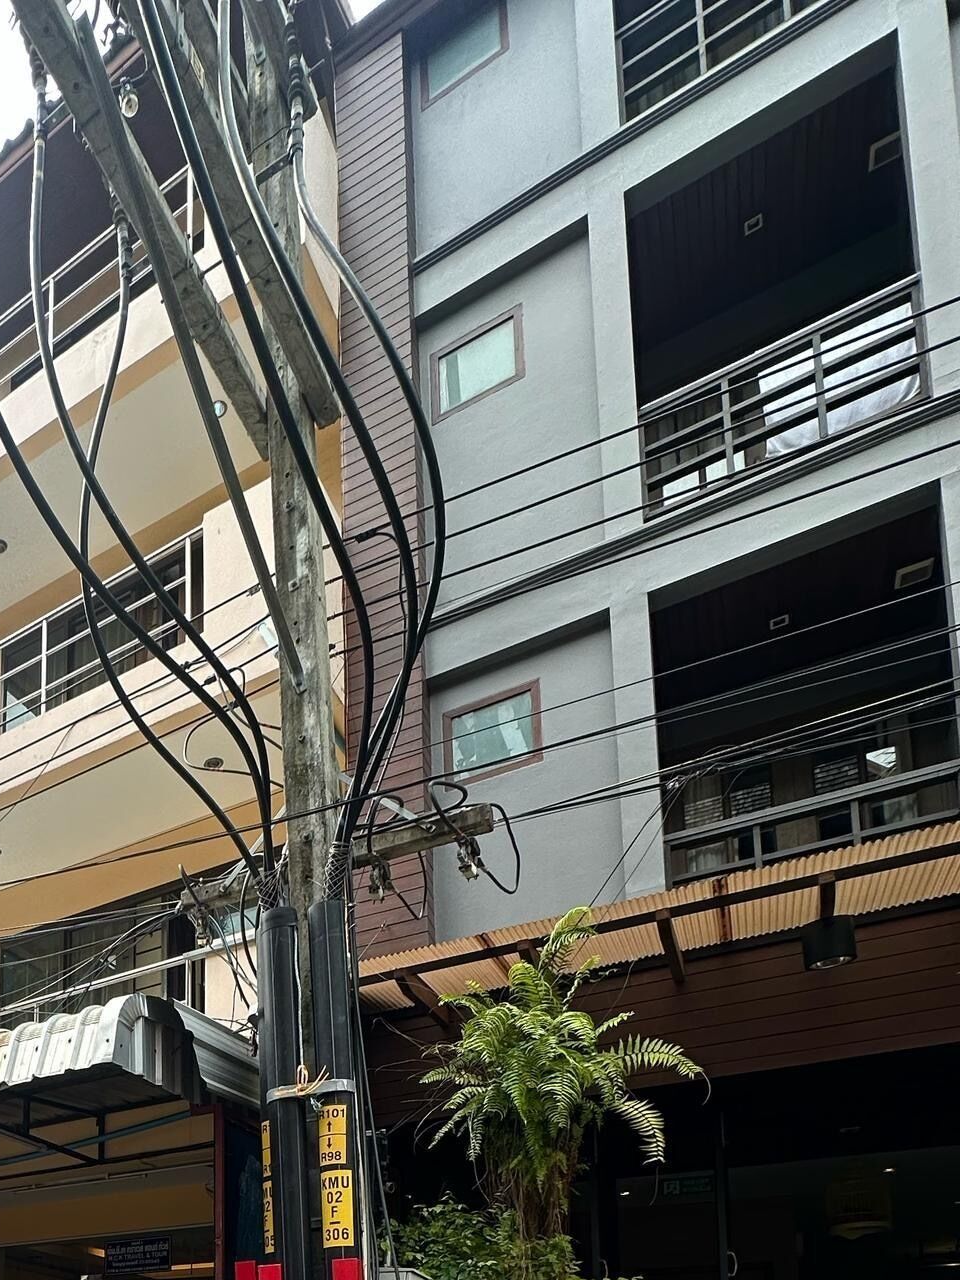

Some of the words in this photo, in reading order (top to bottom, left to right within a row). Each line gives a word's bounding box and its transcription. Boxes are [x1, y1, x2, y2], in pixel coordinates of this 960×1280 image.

[319, 1108, 345, 1120] R101
[321, 1151, 342, 1163] R98
[321, 1175, 349, 1191] KMU
[327, 1191, 342, 1204] 02
[331, 1206, 338, 1218] F
[325, 1227, 349, 1242] 306
